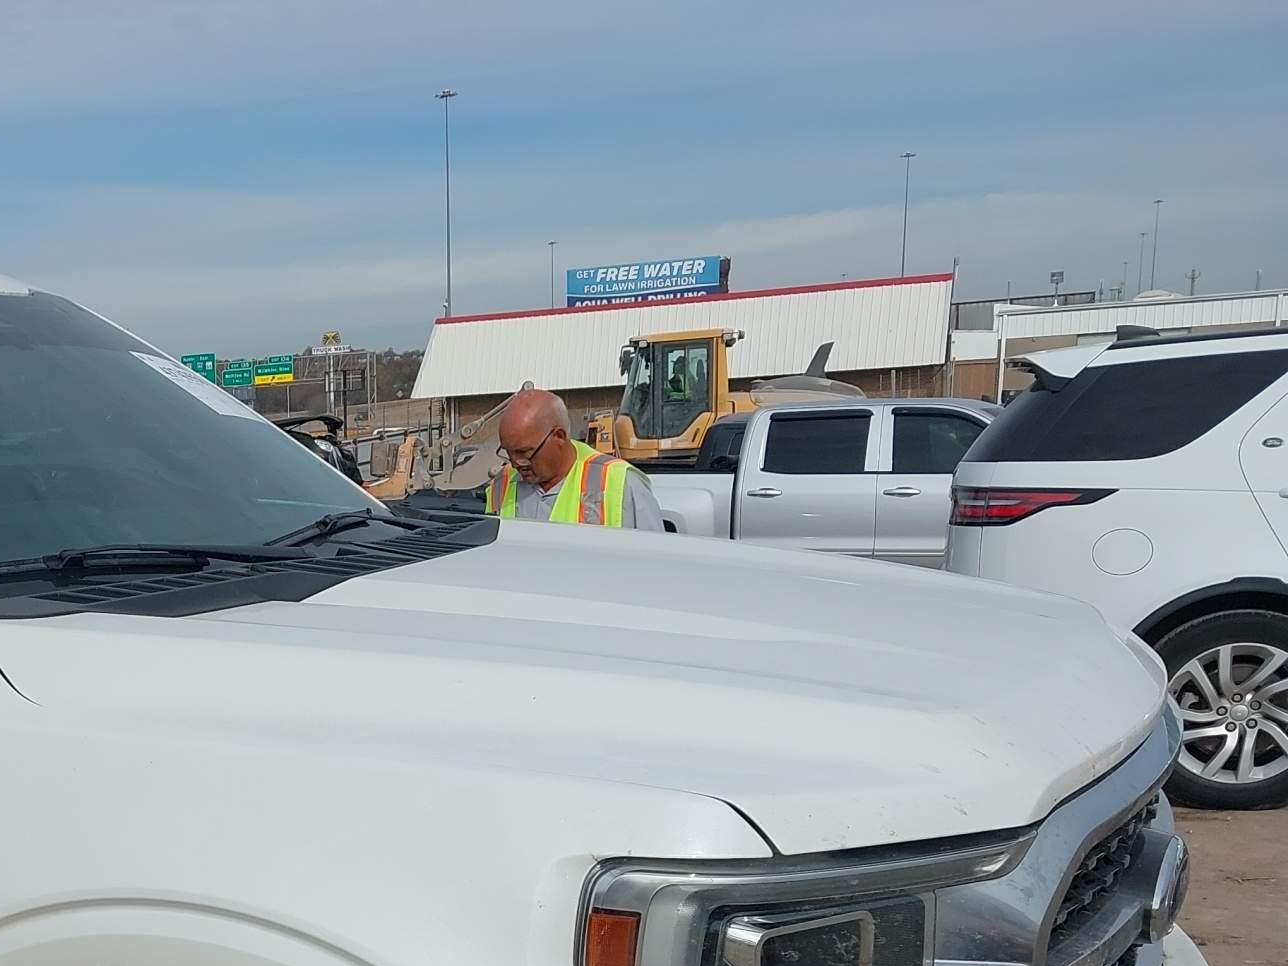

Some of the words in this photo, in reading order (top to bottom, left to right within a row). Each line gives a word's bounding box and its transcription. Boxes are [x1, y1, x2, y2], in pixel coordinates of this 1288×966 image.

[576, 269, 595, 279] GET
[596, 265, 640, 282] FREE
[643, 259, 706, 278] WATER
[584, 283, 604, 294] FOR
[606, 281, 635, 292] LAWN
[637, 276, 697, 289] IRRIGATION
